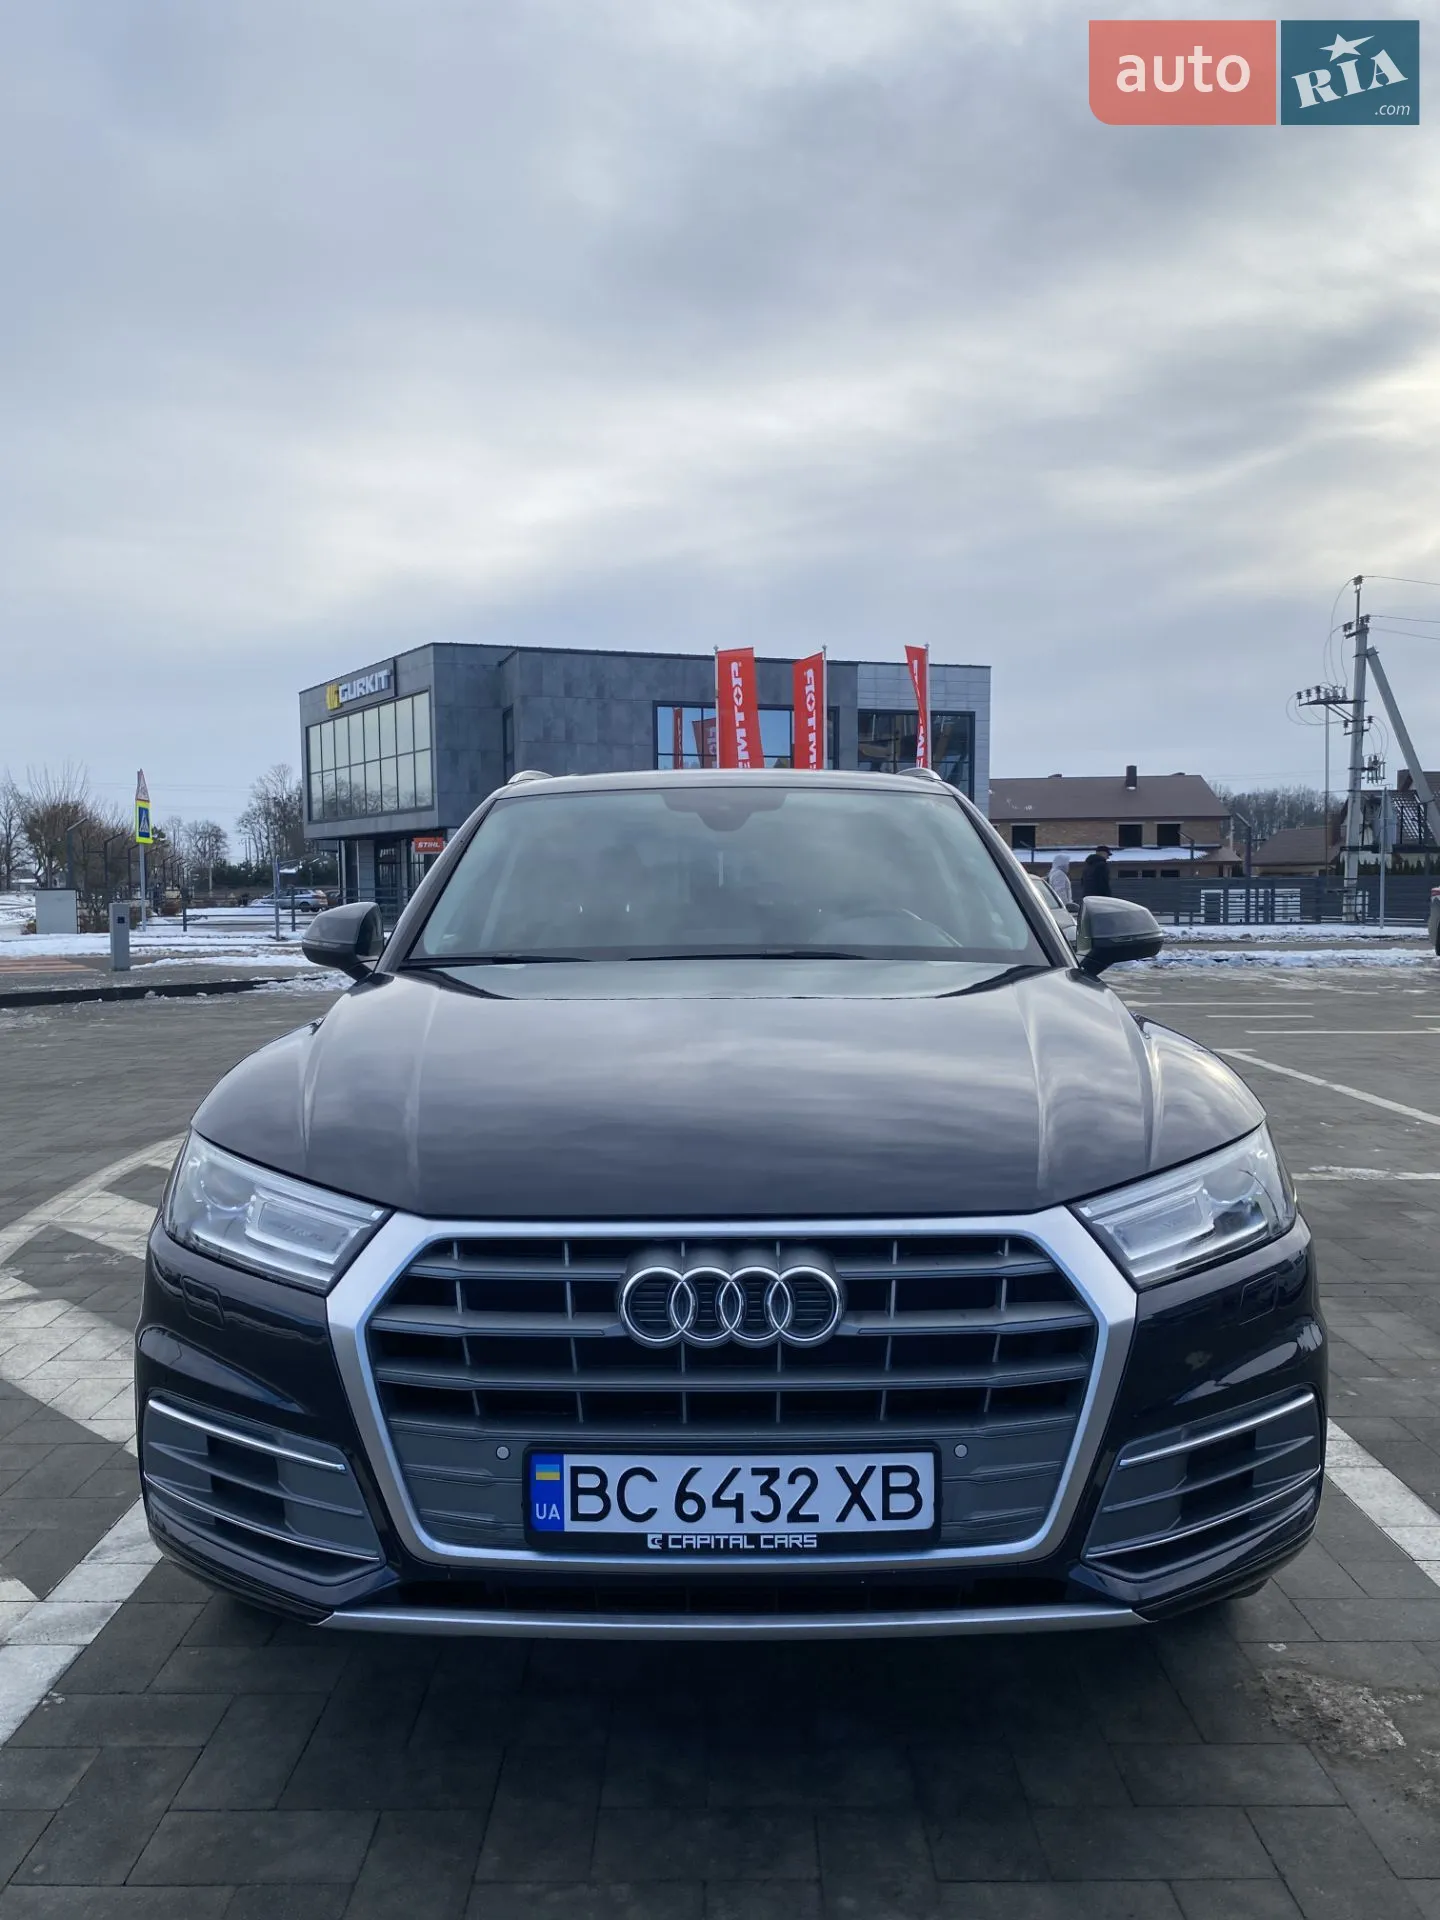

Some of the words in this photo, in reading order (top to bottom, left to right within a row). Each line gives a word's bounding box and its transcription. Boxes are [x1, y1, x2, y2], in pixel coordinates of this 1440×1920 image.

[338, 669, 389, 703] GURKIT
[417, 841, 441, 849] STIHL
[569, 1465, 658, 1522] BC
[674, 1466, 820, 1523] 6432
[835, 1464, 923, 1522] XB
[535, 1503, 560, 1520] UA
[668, 1534, 755, 1549] CAPITAL
[760, 1534, 817, 1548] CARS
